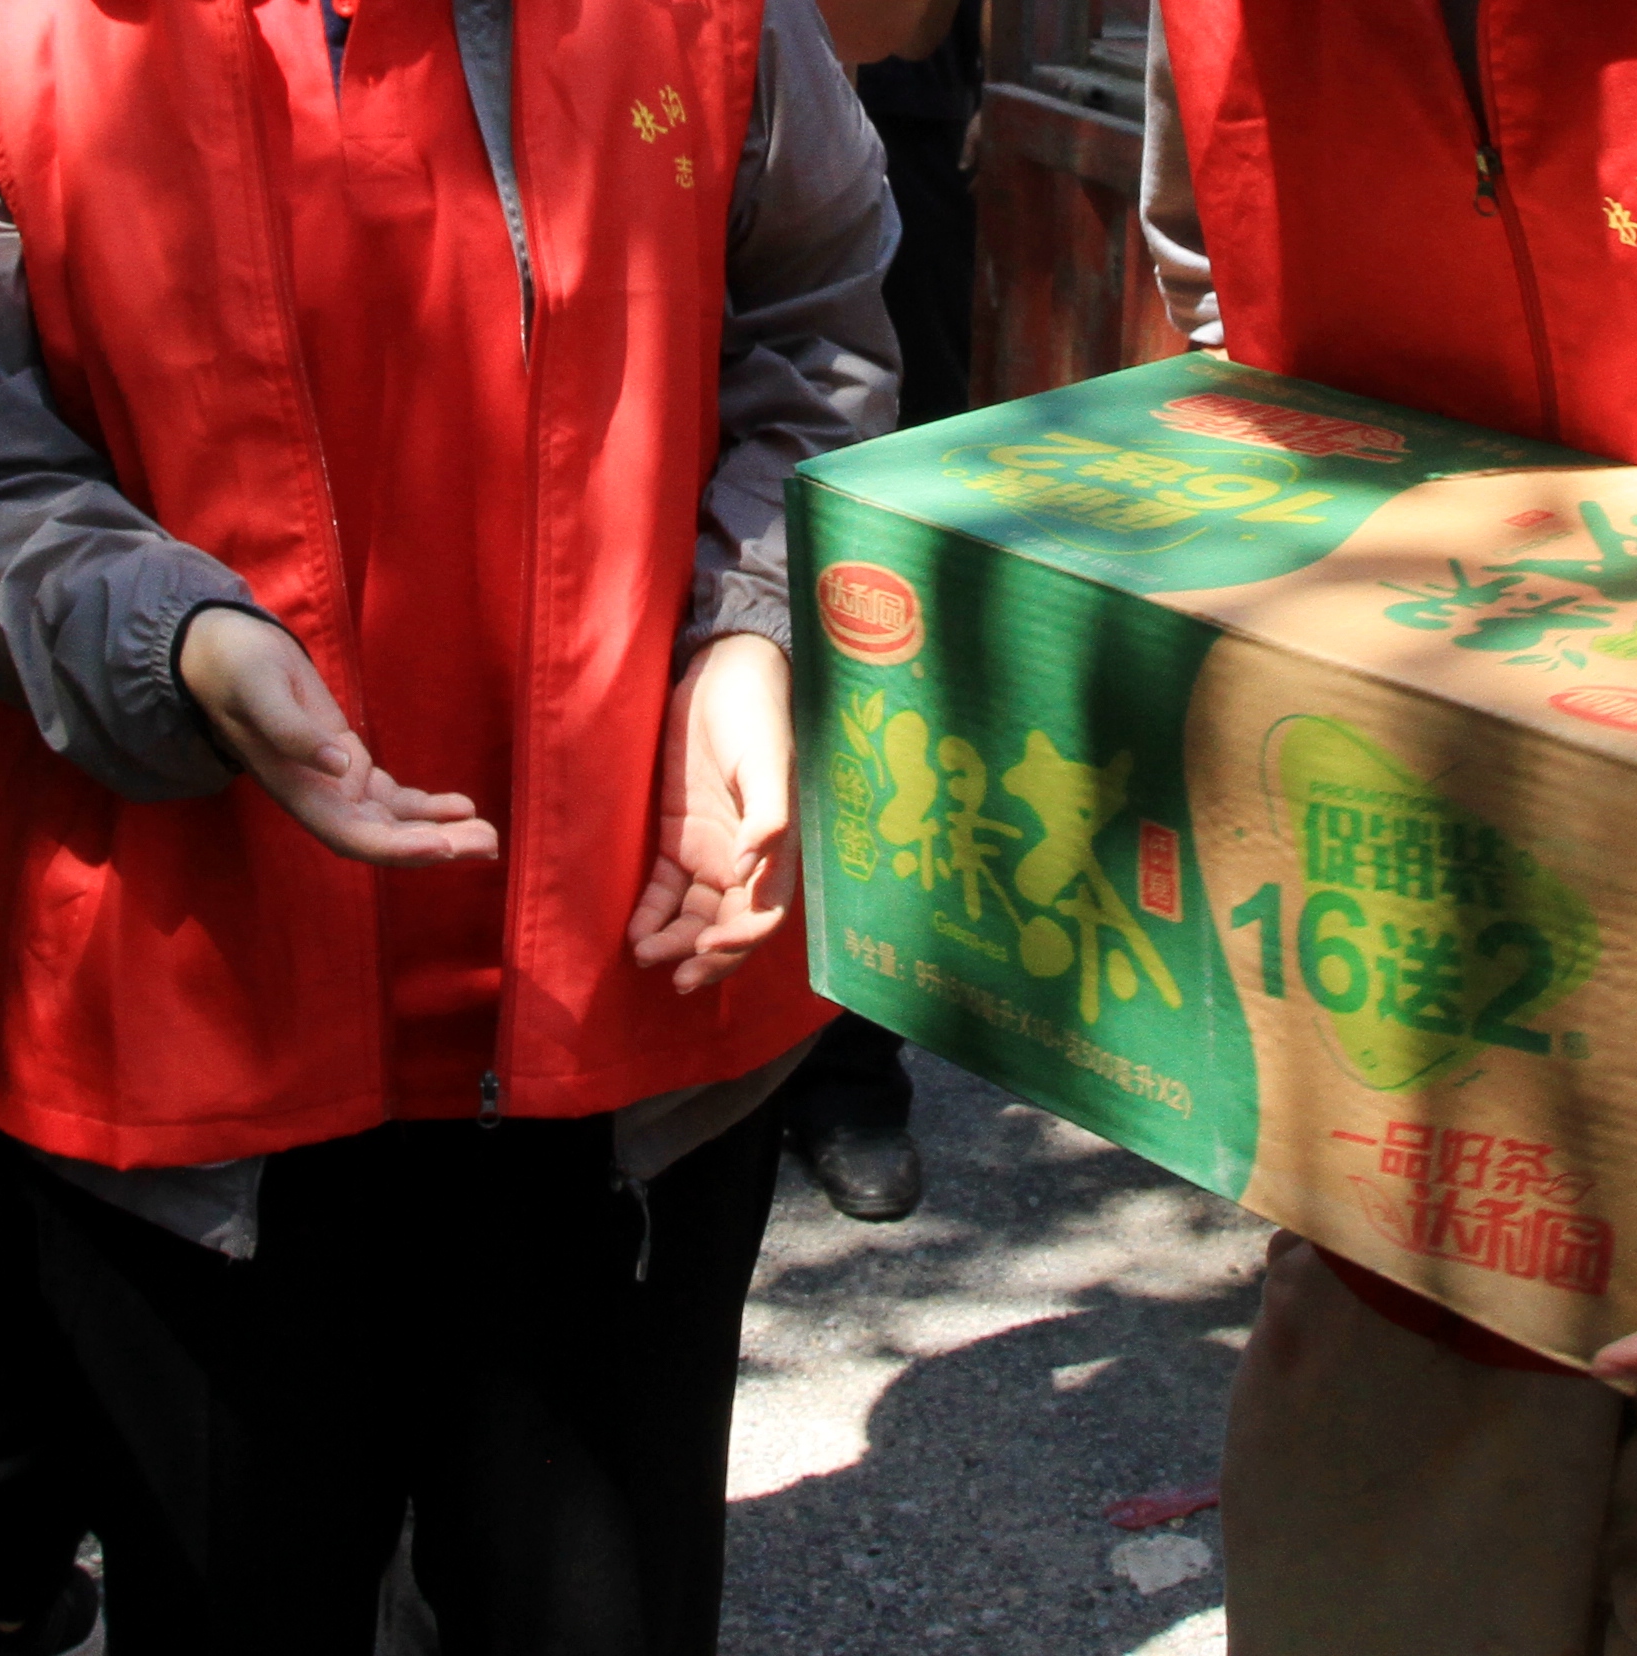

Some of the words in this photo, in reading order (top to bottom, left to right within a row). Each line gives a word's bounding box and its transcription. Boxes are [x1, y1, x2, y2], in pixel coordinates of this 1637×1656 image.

[675, 156, 694, 189] 志
[984, 432, 1336, 526] 16送2
[826, 572, 912, 632] 达利园
[877, 710, 1184, 1024] 绿茶
[1302, 801, 1509, 914] 促销装
[1231, 881, 1557, 1056] 16送2
[1331, 1121, 1554, 1196] 一品好茶
[1406, 1185, 1616, 1296] 达利园
